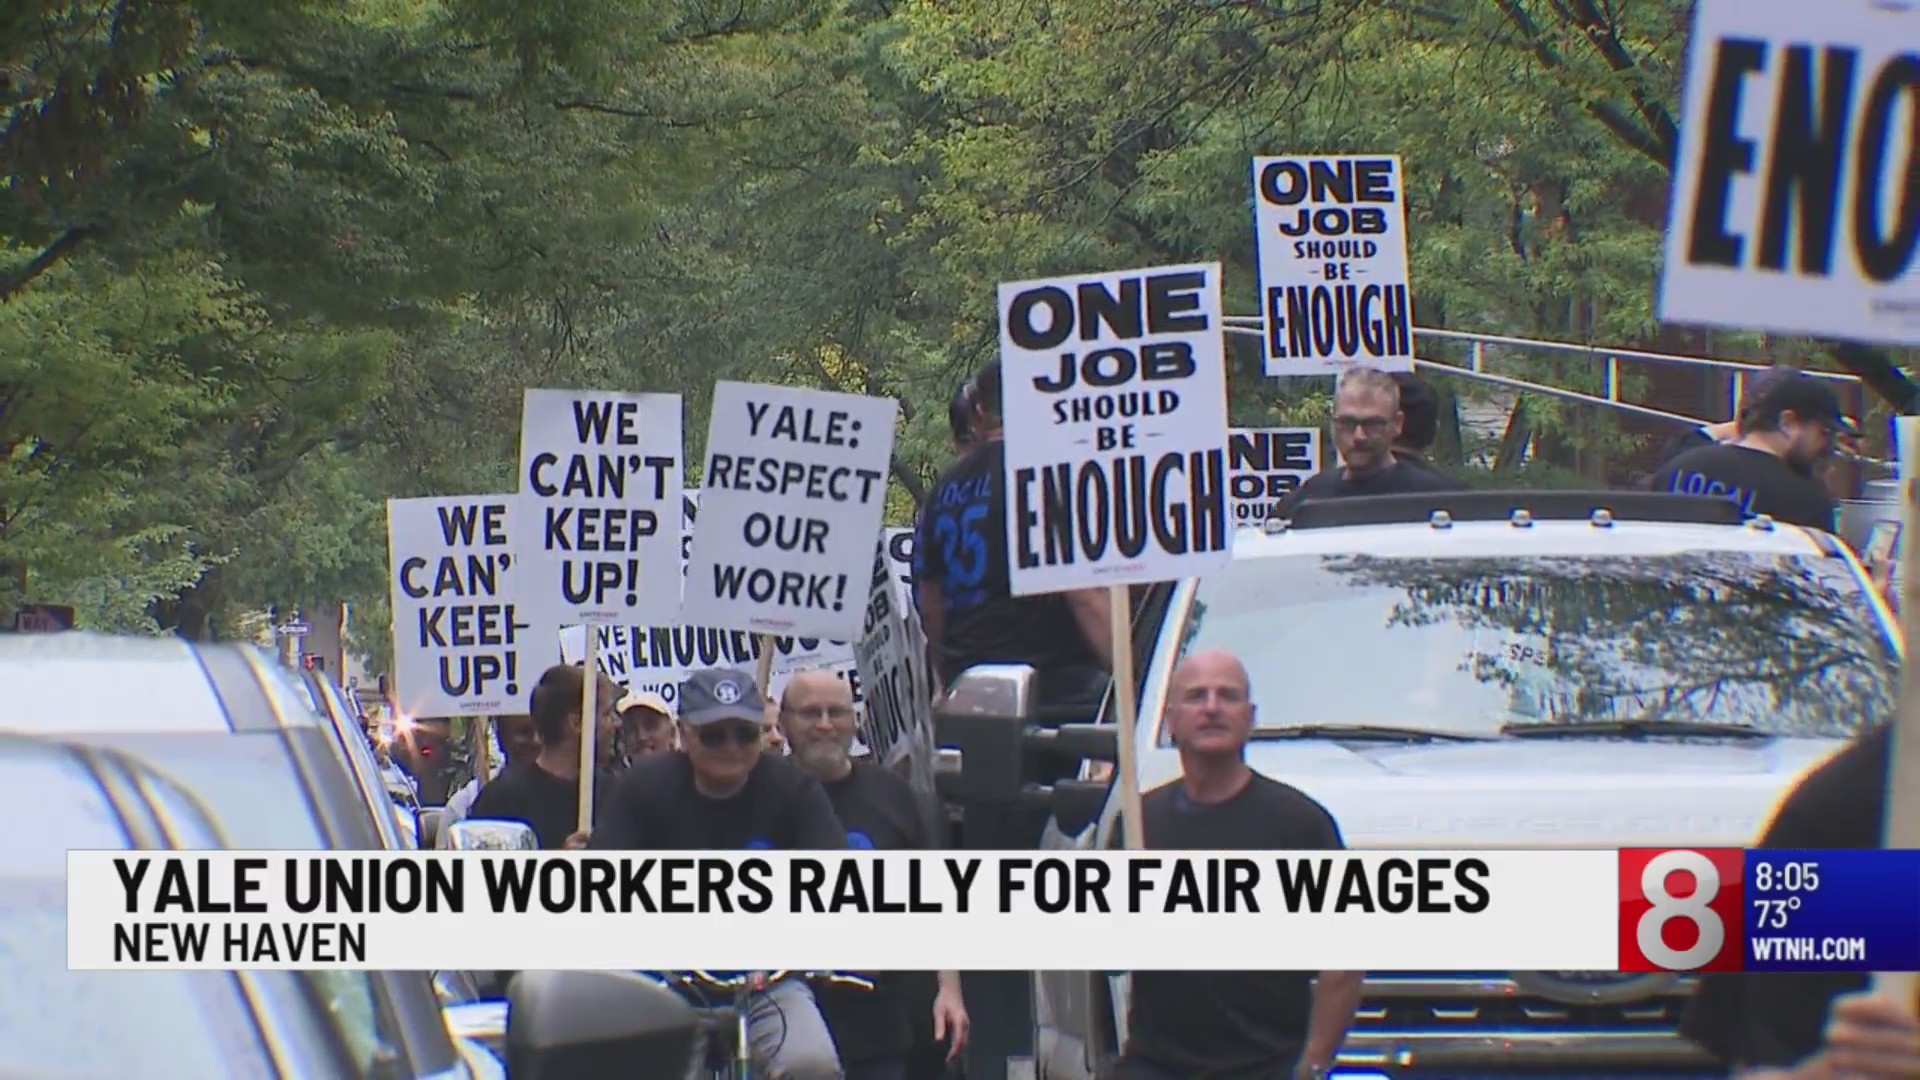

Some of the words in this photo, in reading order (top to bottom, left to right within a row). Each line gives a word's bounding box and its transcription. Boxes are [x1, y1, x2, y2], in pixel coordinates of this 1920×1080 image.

[1260, 160, 1395, 204] ONE
[1687, 38, 1920, 283] ENO
[1279, 207, 1388, 236] JOB
[1293, 240, 1377, 259] SHOULD
[1324, 262, 1350, 281] BE
[1007, 270, 1208, 350] ONE
[1267, 283, 1409, 359] ENOUGH
[1033, 341, 1196, 392] JOB
[572, 401, 638, 445] WE
[746, 401, 862, 449] YALE:
[1053, 389, 1180, 425] SHOULD
[1097, 424, 1135, 452] BE
[1228, 432, 1312, 472] NE
[529, 452, 674, 499] CAN'T
[709, 453, 881, 504] RESPECT
[1230, 474, 1302, 499] OB
[438, 504, 507, 547] WE
[545, 506, 658, 552] KEEP
[1014, 447, 1226, 569] ENOUGH
[743, 512, 829, 554] OUR
[400, 554, 516, 599] CAN'
[562, 558, 638, 607] UP!
[713, 563, 847, 611] WORK!
[440, 654, 518, 697] UP!
